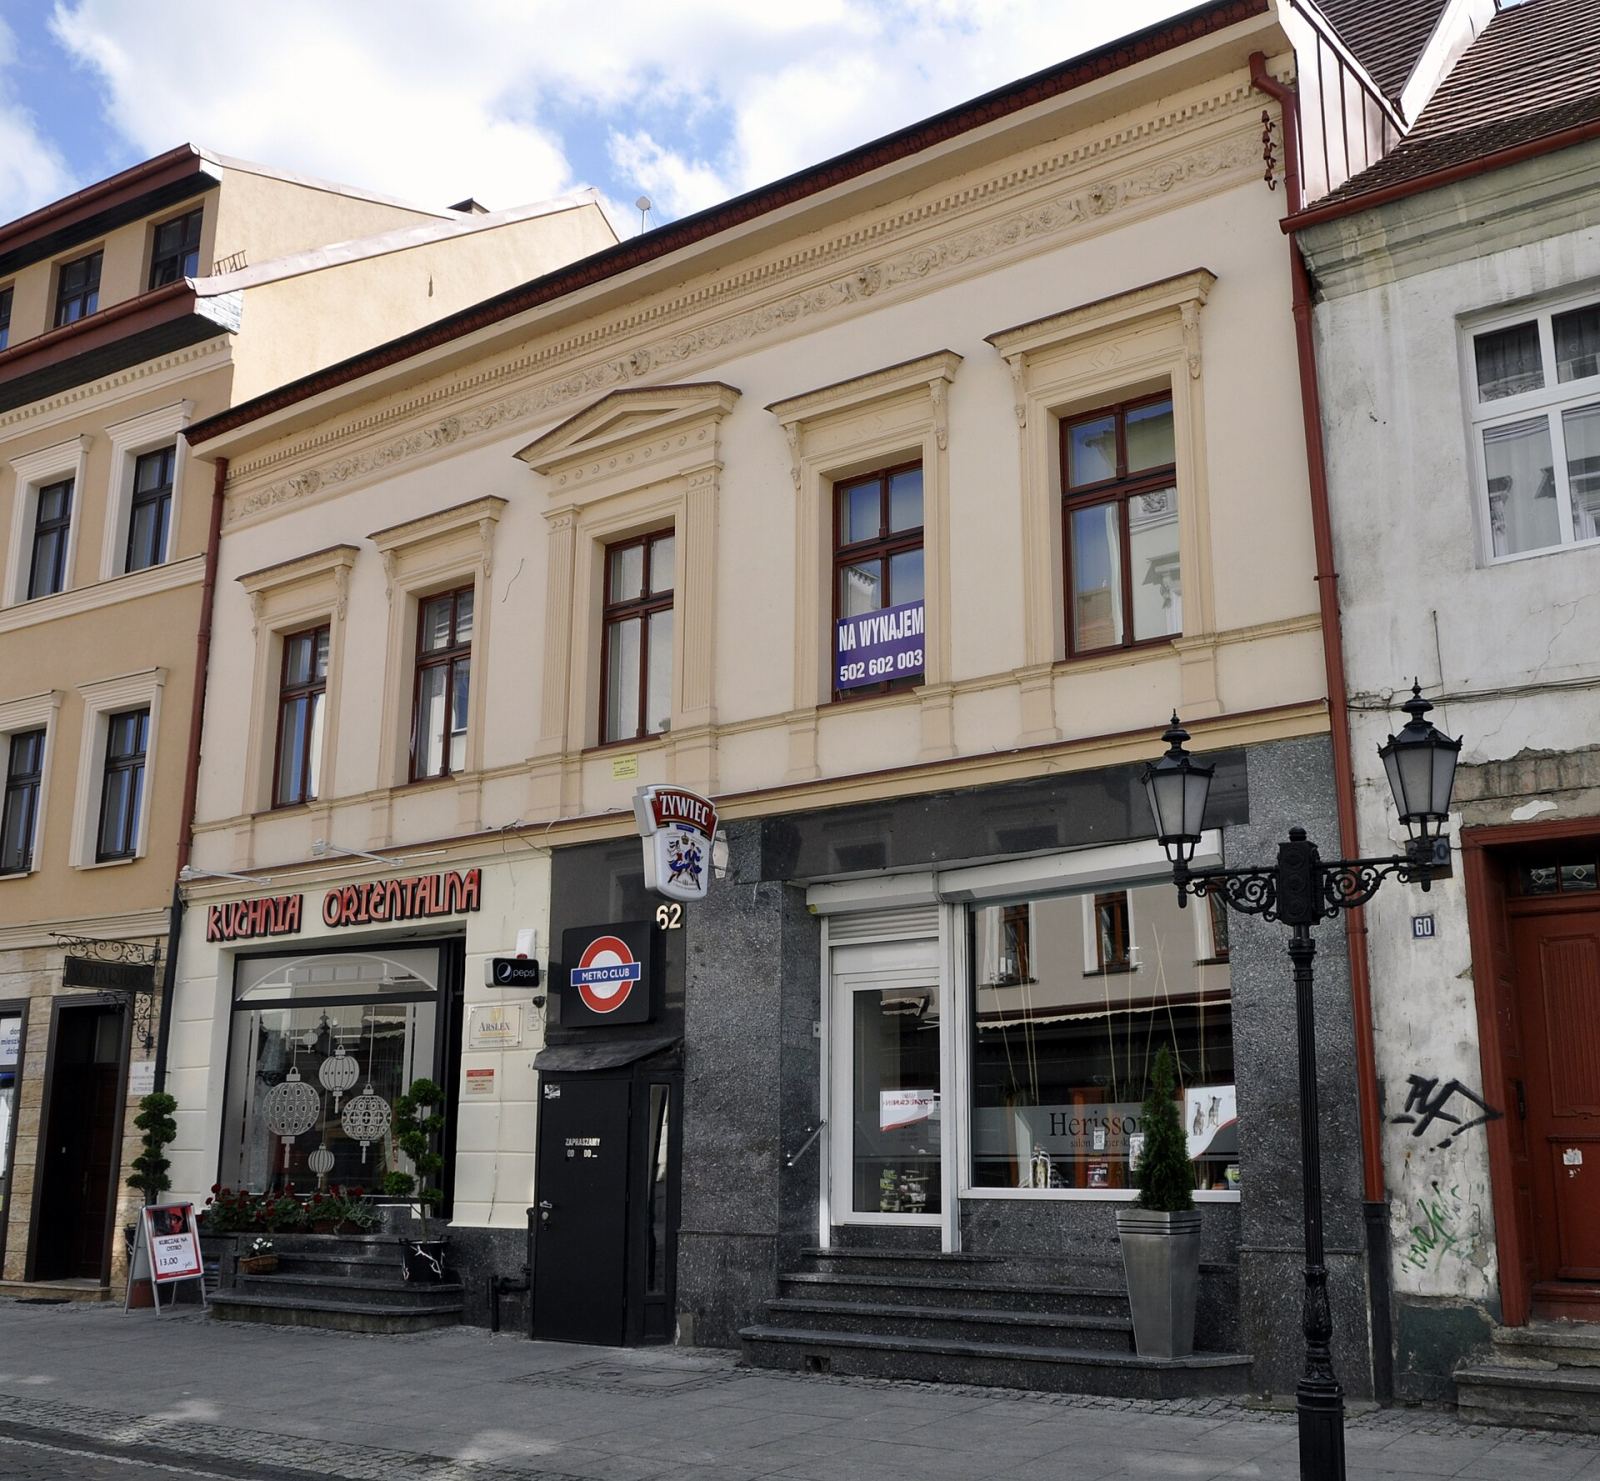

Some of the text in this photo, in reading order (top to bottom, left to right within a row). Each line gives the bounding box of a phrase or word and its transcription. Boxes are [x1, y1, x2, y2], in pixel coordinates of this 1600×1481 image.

[839, 606, 924, 652] NA WYNAJEM
[840, 649, 923, 681] 502 602 003
[660, 791, 710, 826] ŻYWIEC
[206, 868, 482, 942] KUCHNIA ORIENTALNA
[656, 903, 682, 931] 62
[1415, 917, 1431, 936] 60
[512, 968, 536, 979] pepsi
[582, 968, 630, 981] METRO CLUB
[565, 1137, 601, 1146] ZAPRASZAMY
